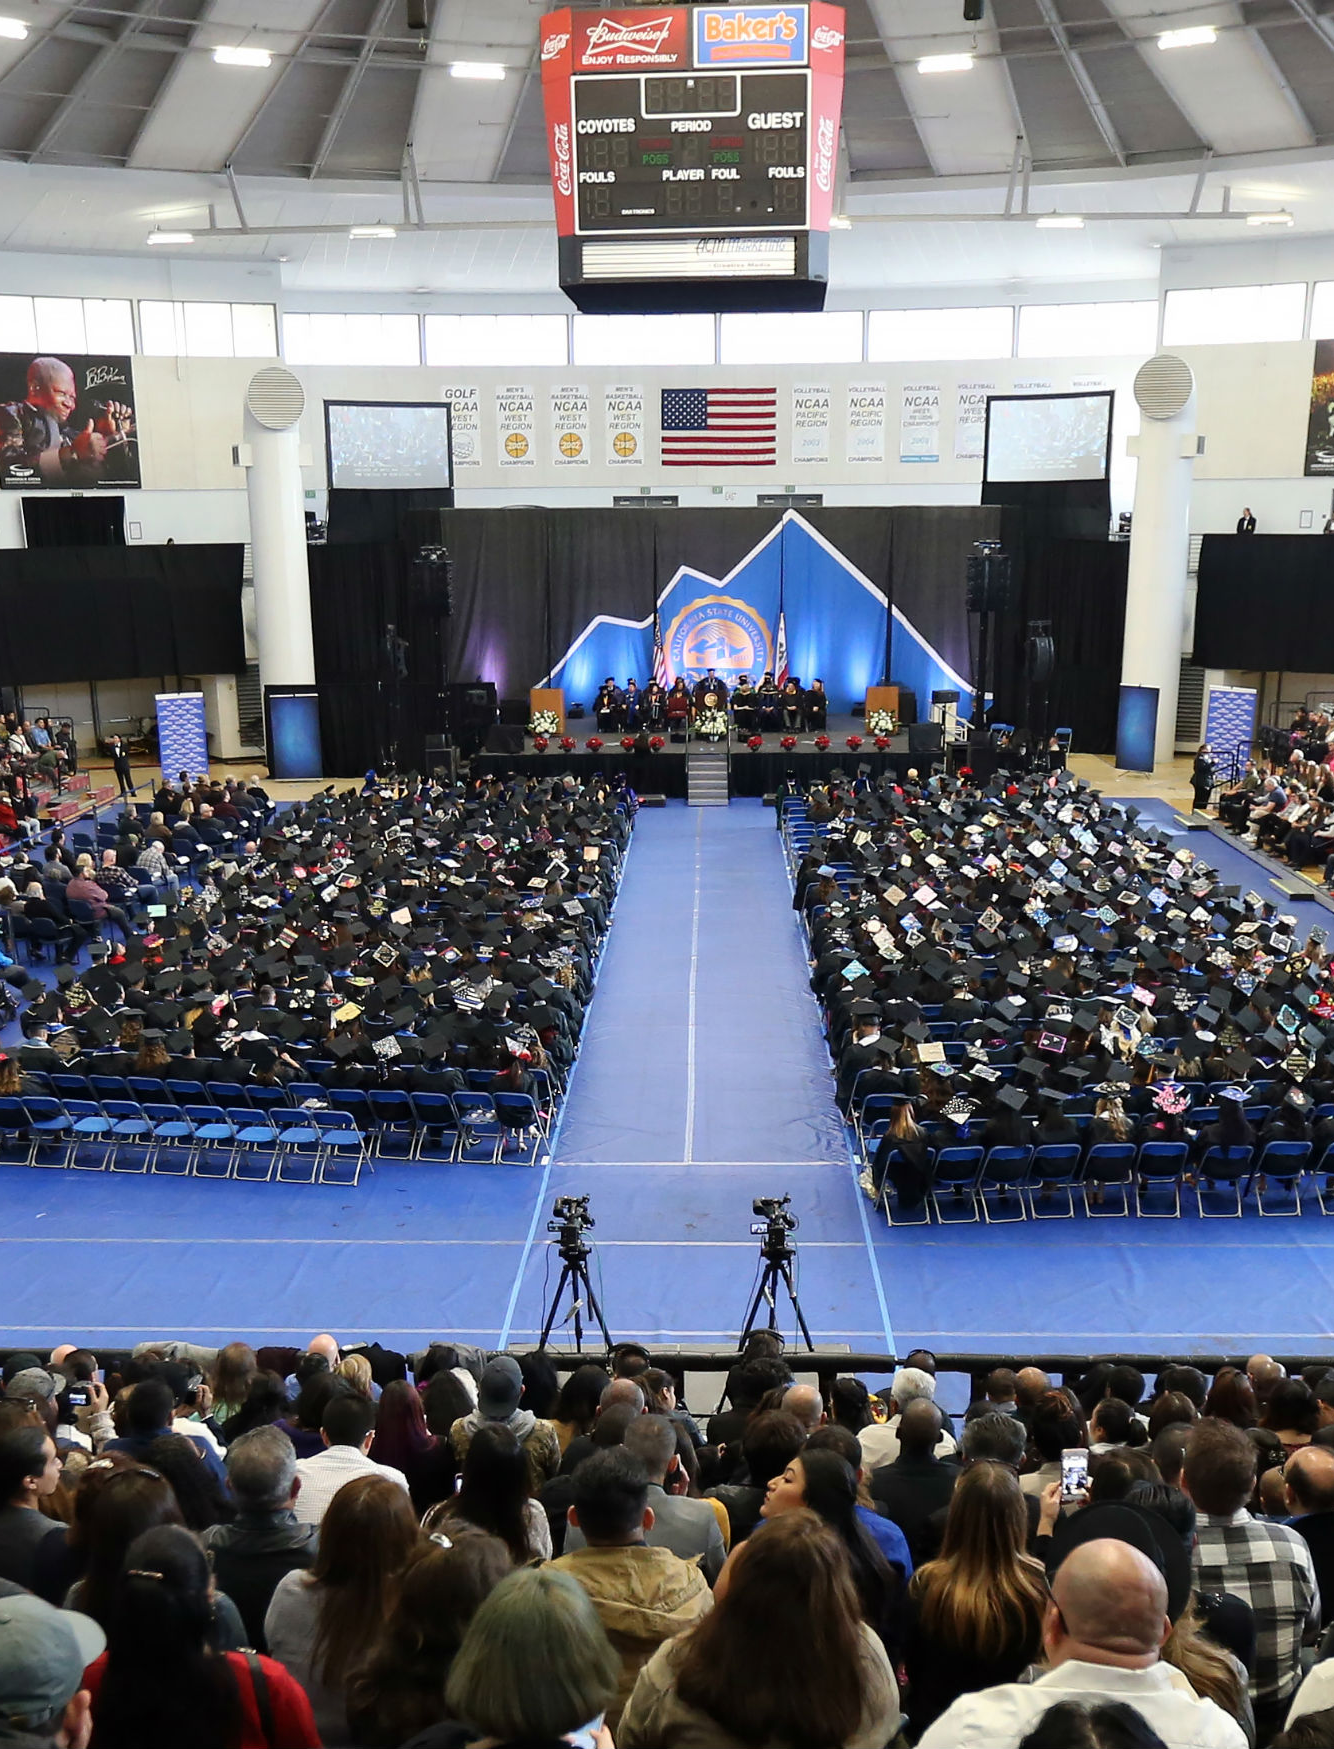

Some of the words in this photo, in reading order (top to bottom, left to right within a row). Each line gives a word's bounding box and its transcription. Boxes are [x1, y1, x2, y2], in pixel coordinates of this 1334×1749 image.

[704, 10, 798, 42] Baker's
[586, 25, 670, 44] Budweiser
[581, 54, 613, 65] ENJOY
[616, 52, 678, 65] RESPONSIBLY
[577, 118, 636, 134] COYOTES
[671, 120, 712, 132] PERIOD
[747, 112, 804, 130] GUEST
[554, 122, 572, 197] Coca-Cola
[642, 154, 669, 165] POSS
[713, 152, 740, 163] POSS
[815, 115, 834, 193] Coca-Cola
[579, 171, 616, 183] FOULS
[662, 169, 705, 181] PLAYER
[711, 168, 740, 180] FOUL
[768, 167, 805, 179] FOULS
[727, 237, 786, 253] MARKETING
[444, 389, 477, 399] GOLF
[959, 394, 986, 405] NCA
[453, 401, 478, 412] CAA
[499, 401, 533, 412] NCAA
[553, 401, 588, 411] NCAA
[608, 401, 642, 411] NCAA
[795, 398, 829, 409] NCAA
[849, 397, 884, 408] NCAA
[904, 396, 939, 407] NCAA
[613, 413, 637, 421] WEST
[851, 410, 882, 418] PACIFIC
[959, 416, 986, 424] REGIO
[452, 423, 478, 431] EGION
[555, 422, 587, 430] REGION
[673, 612, 705, 662] CALIFORNIA
[706, 607, 734, 617] STATE
[734, 613, 764, 663] UNIVERSITY
